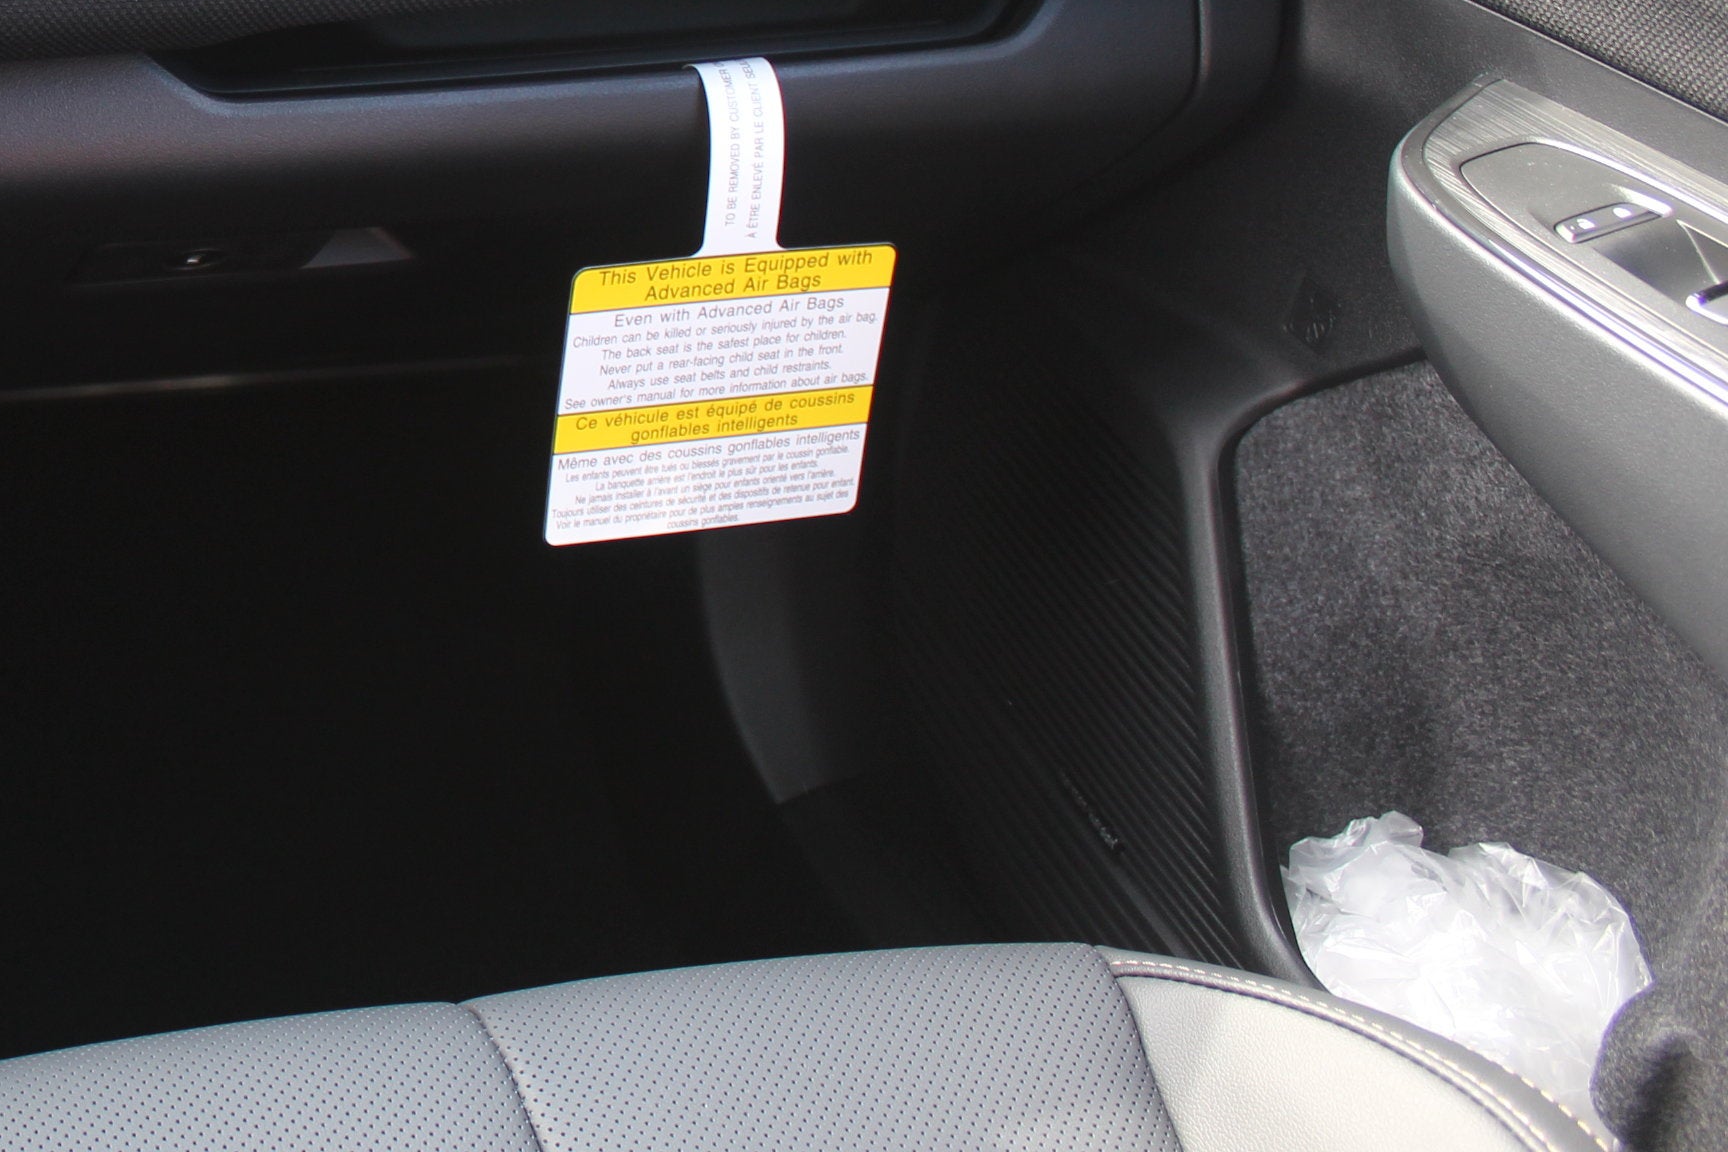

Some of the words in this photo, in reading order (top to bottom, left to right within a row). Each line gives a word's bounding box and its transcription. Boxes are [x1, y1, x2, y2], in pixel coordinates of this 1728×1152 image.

[749, 82, 763, 118] CLIENT
[730, 125, 740, 140] BY
[754, 121, 764, 134] LE
[754, 136, 764, 158] PAR
[729, 143, 740, 193] REMOVED
[727, 197, 737, 210] BE
[725, 213, 735, 227] TO
[600, 270, 636, 286] This
[647, 262, 712, 281] Vehicle
[721, 260, 735, 275] is
[744, 252, 829, 275] Equipped
[838, 250, 872, 266] with
[644, 279, 735, 301] Advanced
[743, 277, 769, 293] Air
[776, 274, 821, 292] Bags
[614, 314, 652, 328] Even
[660, 309, 690, 323] with
[697, 301, 772, 320] Advanced
[779, 299, 800, 312] Air
[807, 296, 844, 310] Bags
[573, 335, 617, 348] Children
[622, 333, 641, 344] can
[646, 331, 660, 341] be
[665, 327, 691, 338] killed
[696, 327, 707, 336] or
[711, 321, 757, 335] seriously
[762, 318, 797, 330] injured
[801, 317, 814, 329] by
[818, 315, 834, 325] the
[838, 313, 853, 324] air
[602, 349, 622, 360] The
[626, 346, 652, 358] back
[656, 344, 679, 355] seat
[683, 342, 692, 352] is
[697, 341, 713, 352] the
[718, 337, 750, 349] safest
[753, 334, 782, 346] place
[786, 333, 800, 342] for
[600, 364, 631, 377] Never
[636, 362, 653, 373] put
[657, 361, 664, 370] a
[669, 355, 725, 369] rear-facing
[729, 352, 753, 363] child
[758, 350, 780, 361] seat
[784, 348, 794, 358] in
[798, 347, 814, 357] the
[564, 398, 586, 410] See
[637, 389, 676, 403] manual
[680, 387, 694, 398] for
[699, 385, 726, 396] more
[730, 379, 787, 393] information
[791, 376, 821, 388] about
[824, 373, 837, 384] air
[608, 378, 645, 391] Always
[650, 376, 670, 386] use
[674, 372, 696, 384] seat
[701, 369, 726, 381] belts
[730, 365, 750, 377] and
[754, 364, 778, 376] child
[575, 417, 598, 431] Ce
[606, 409, 669, 427] véhicule
[676, 406, 699, 420] est
[706, 400, 757, 418] équipé
[765, 399, 783, 412] de
[789, 392, 855, 409] coussins
[631, 422, 710, 444] gonflables
[717, 414, 799, 433] intelligents
[558, 458, 598, 470] Même
[604, 454, 634, 466] avec
[639, 450, 662, 462] des
[667, 444, 722, 459] coussins
[728, 437, 791, 455] gonflables
[796, 430, 860, 445] intelligents
